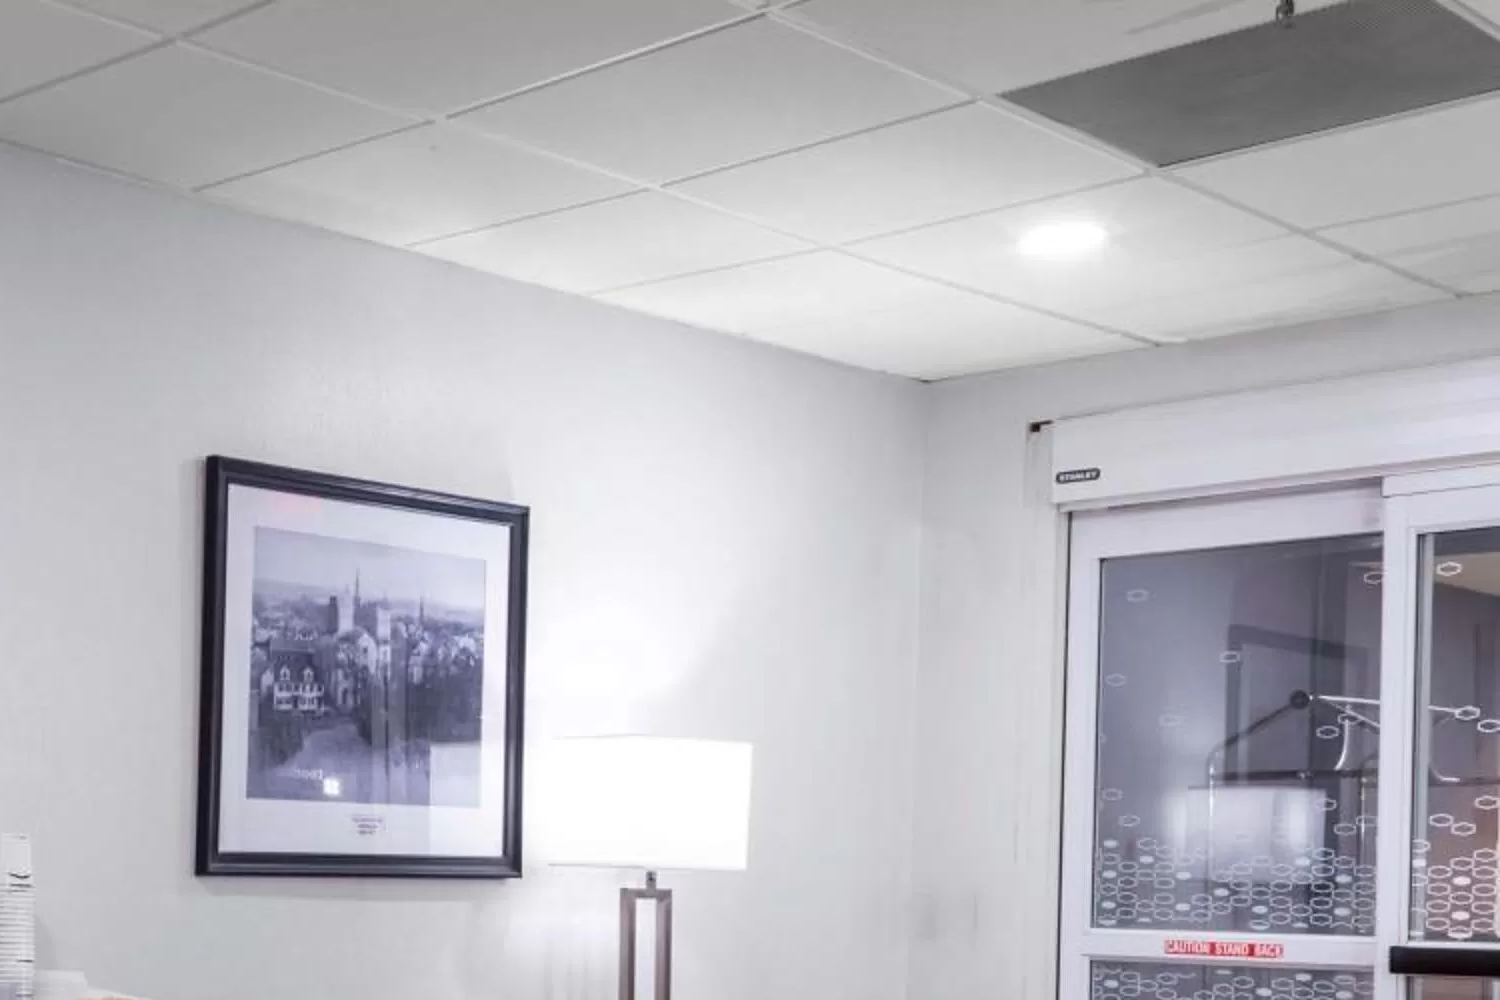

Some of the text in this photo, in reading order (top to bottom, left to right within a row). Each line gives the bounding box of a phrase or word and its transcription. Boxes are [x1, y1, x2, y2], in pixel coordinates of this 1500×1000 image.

[1059, 470, 1098, 480] STANLEY
[1164, 939, 1284, 958] CAUTION STAND BACK
